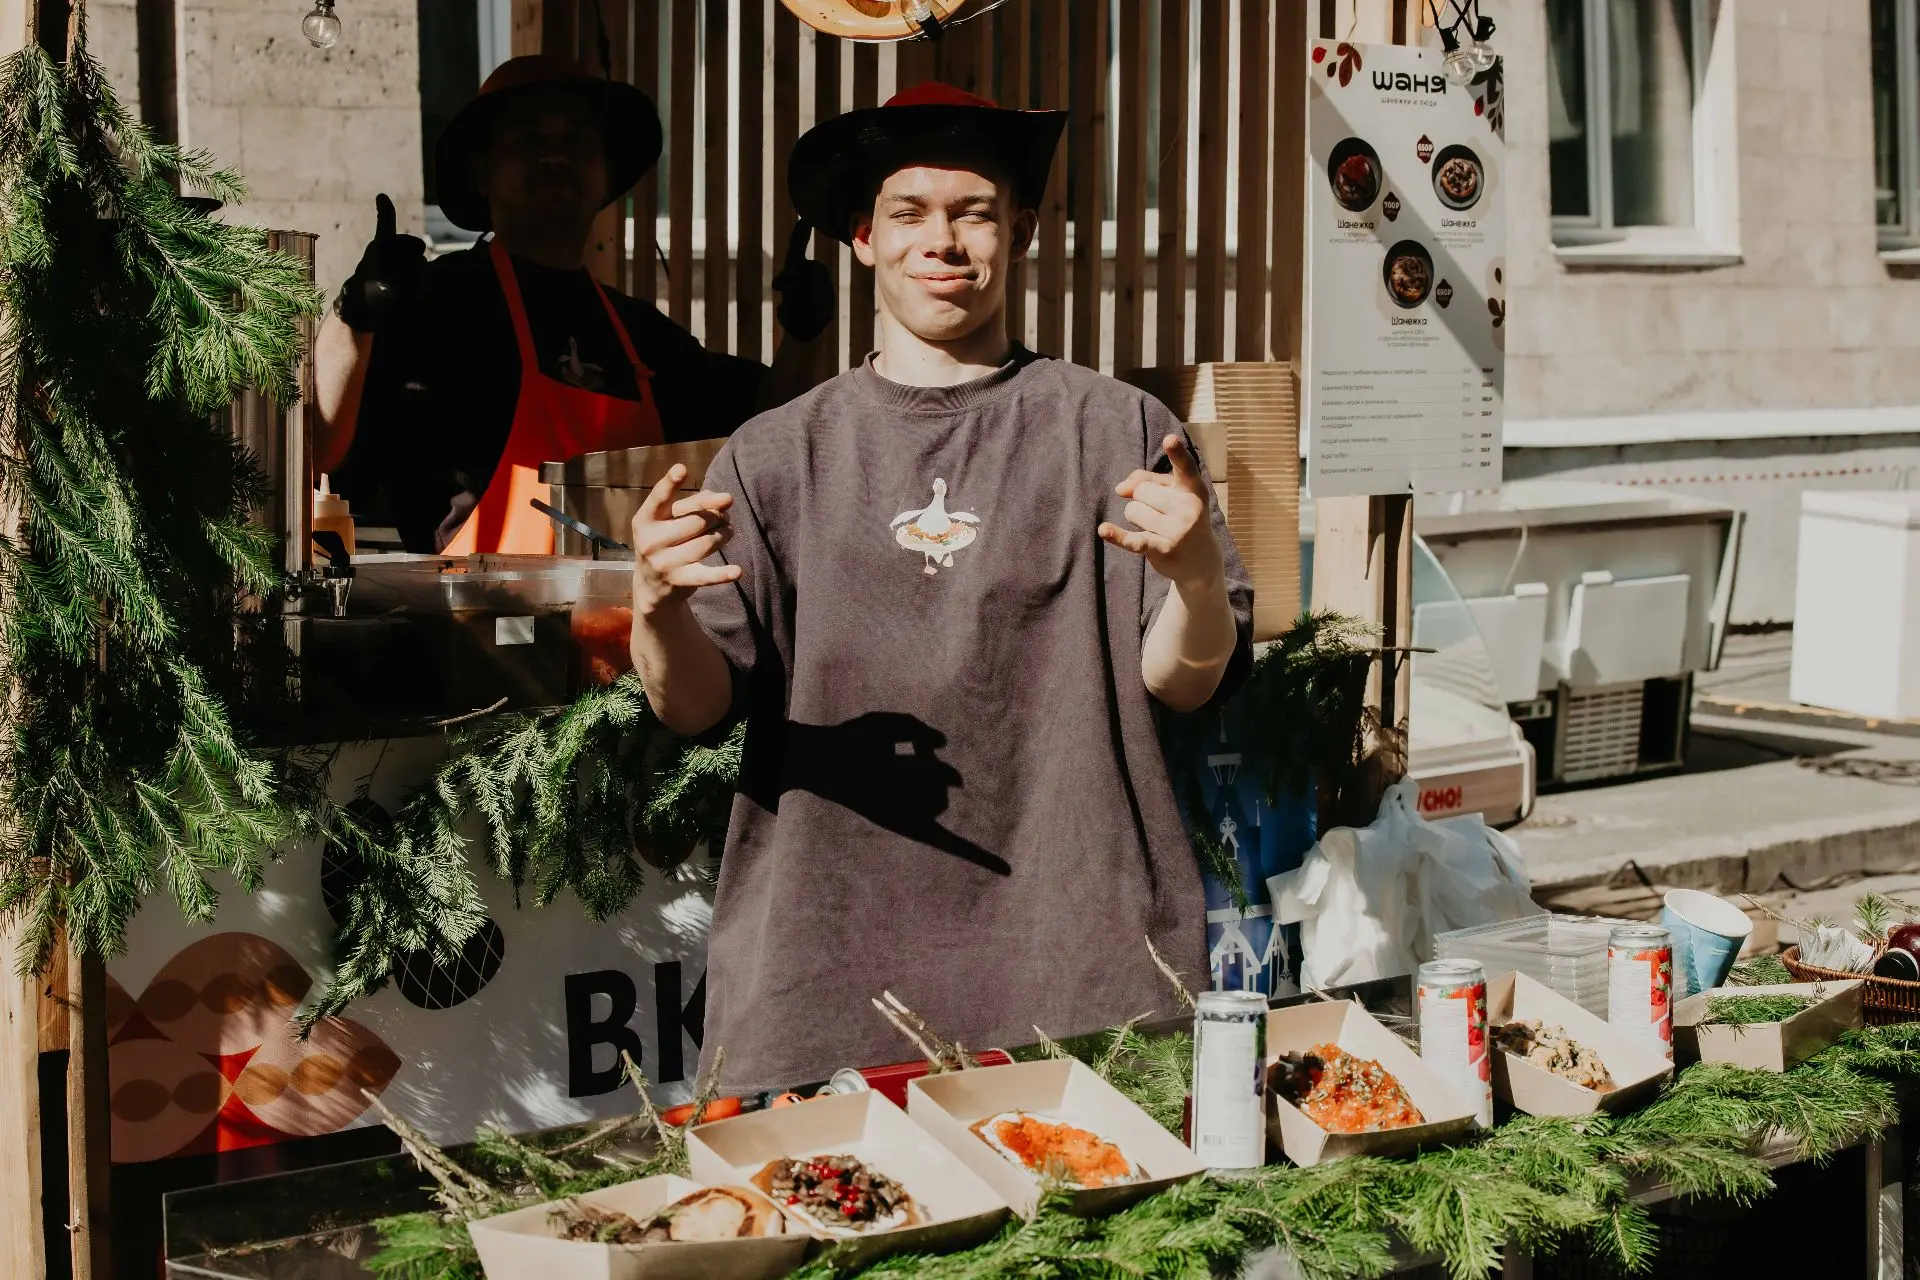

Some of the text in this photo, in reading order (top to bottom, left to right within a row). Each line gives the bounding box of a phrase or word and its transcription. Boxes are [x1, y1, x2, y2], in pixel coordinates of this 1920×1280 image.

[1337, 219, 1375, 229] Шанежка
[1441, 218, 1476, 228] Шанежка
[1391, 316, 1427, 326] Шанежка
